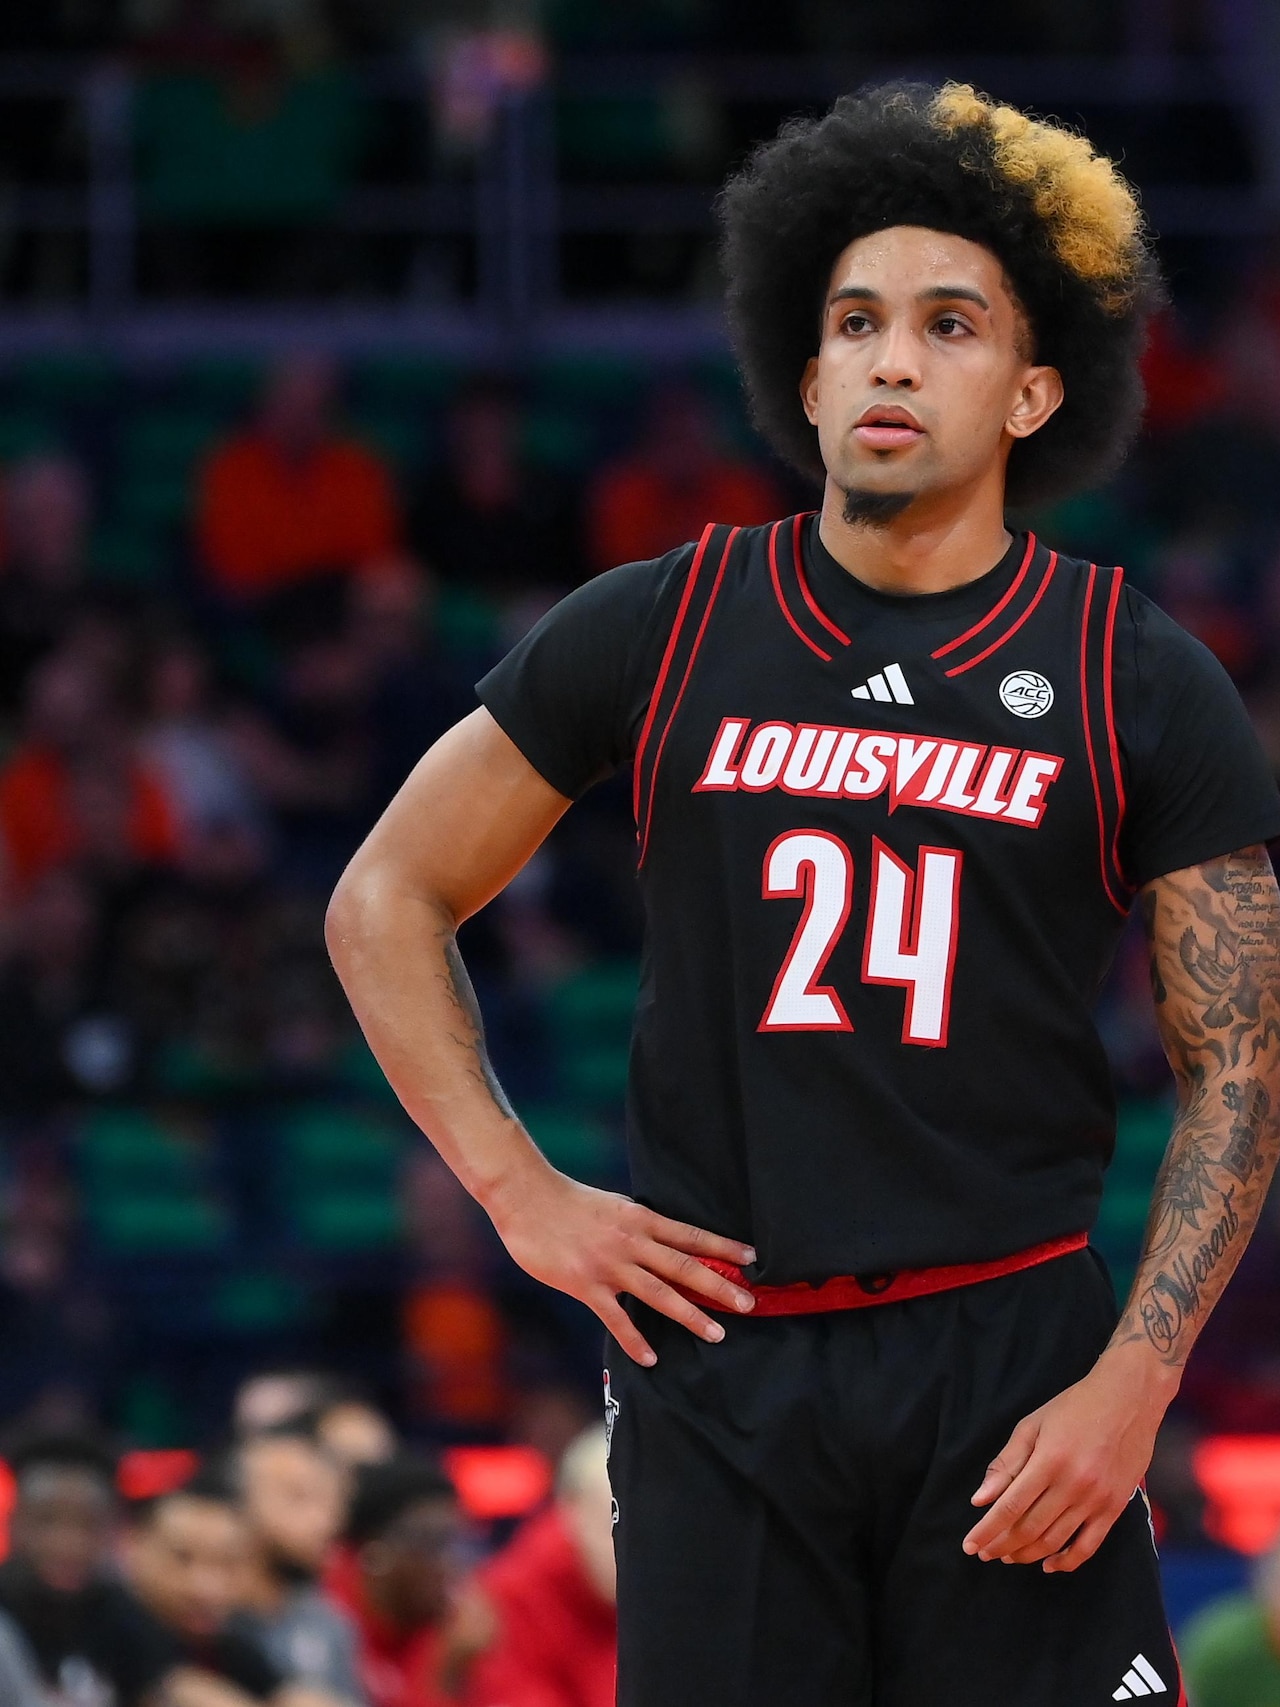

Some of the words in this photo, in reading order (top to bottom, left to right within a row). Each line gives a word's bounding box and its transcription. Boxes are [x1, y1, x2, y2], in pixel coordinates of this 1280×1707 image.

[1008, 686, 1049, 700] ACC
[691, 716, 1065, 829] LOUISVILLE
[756, 828, 964, 1048] 24
